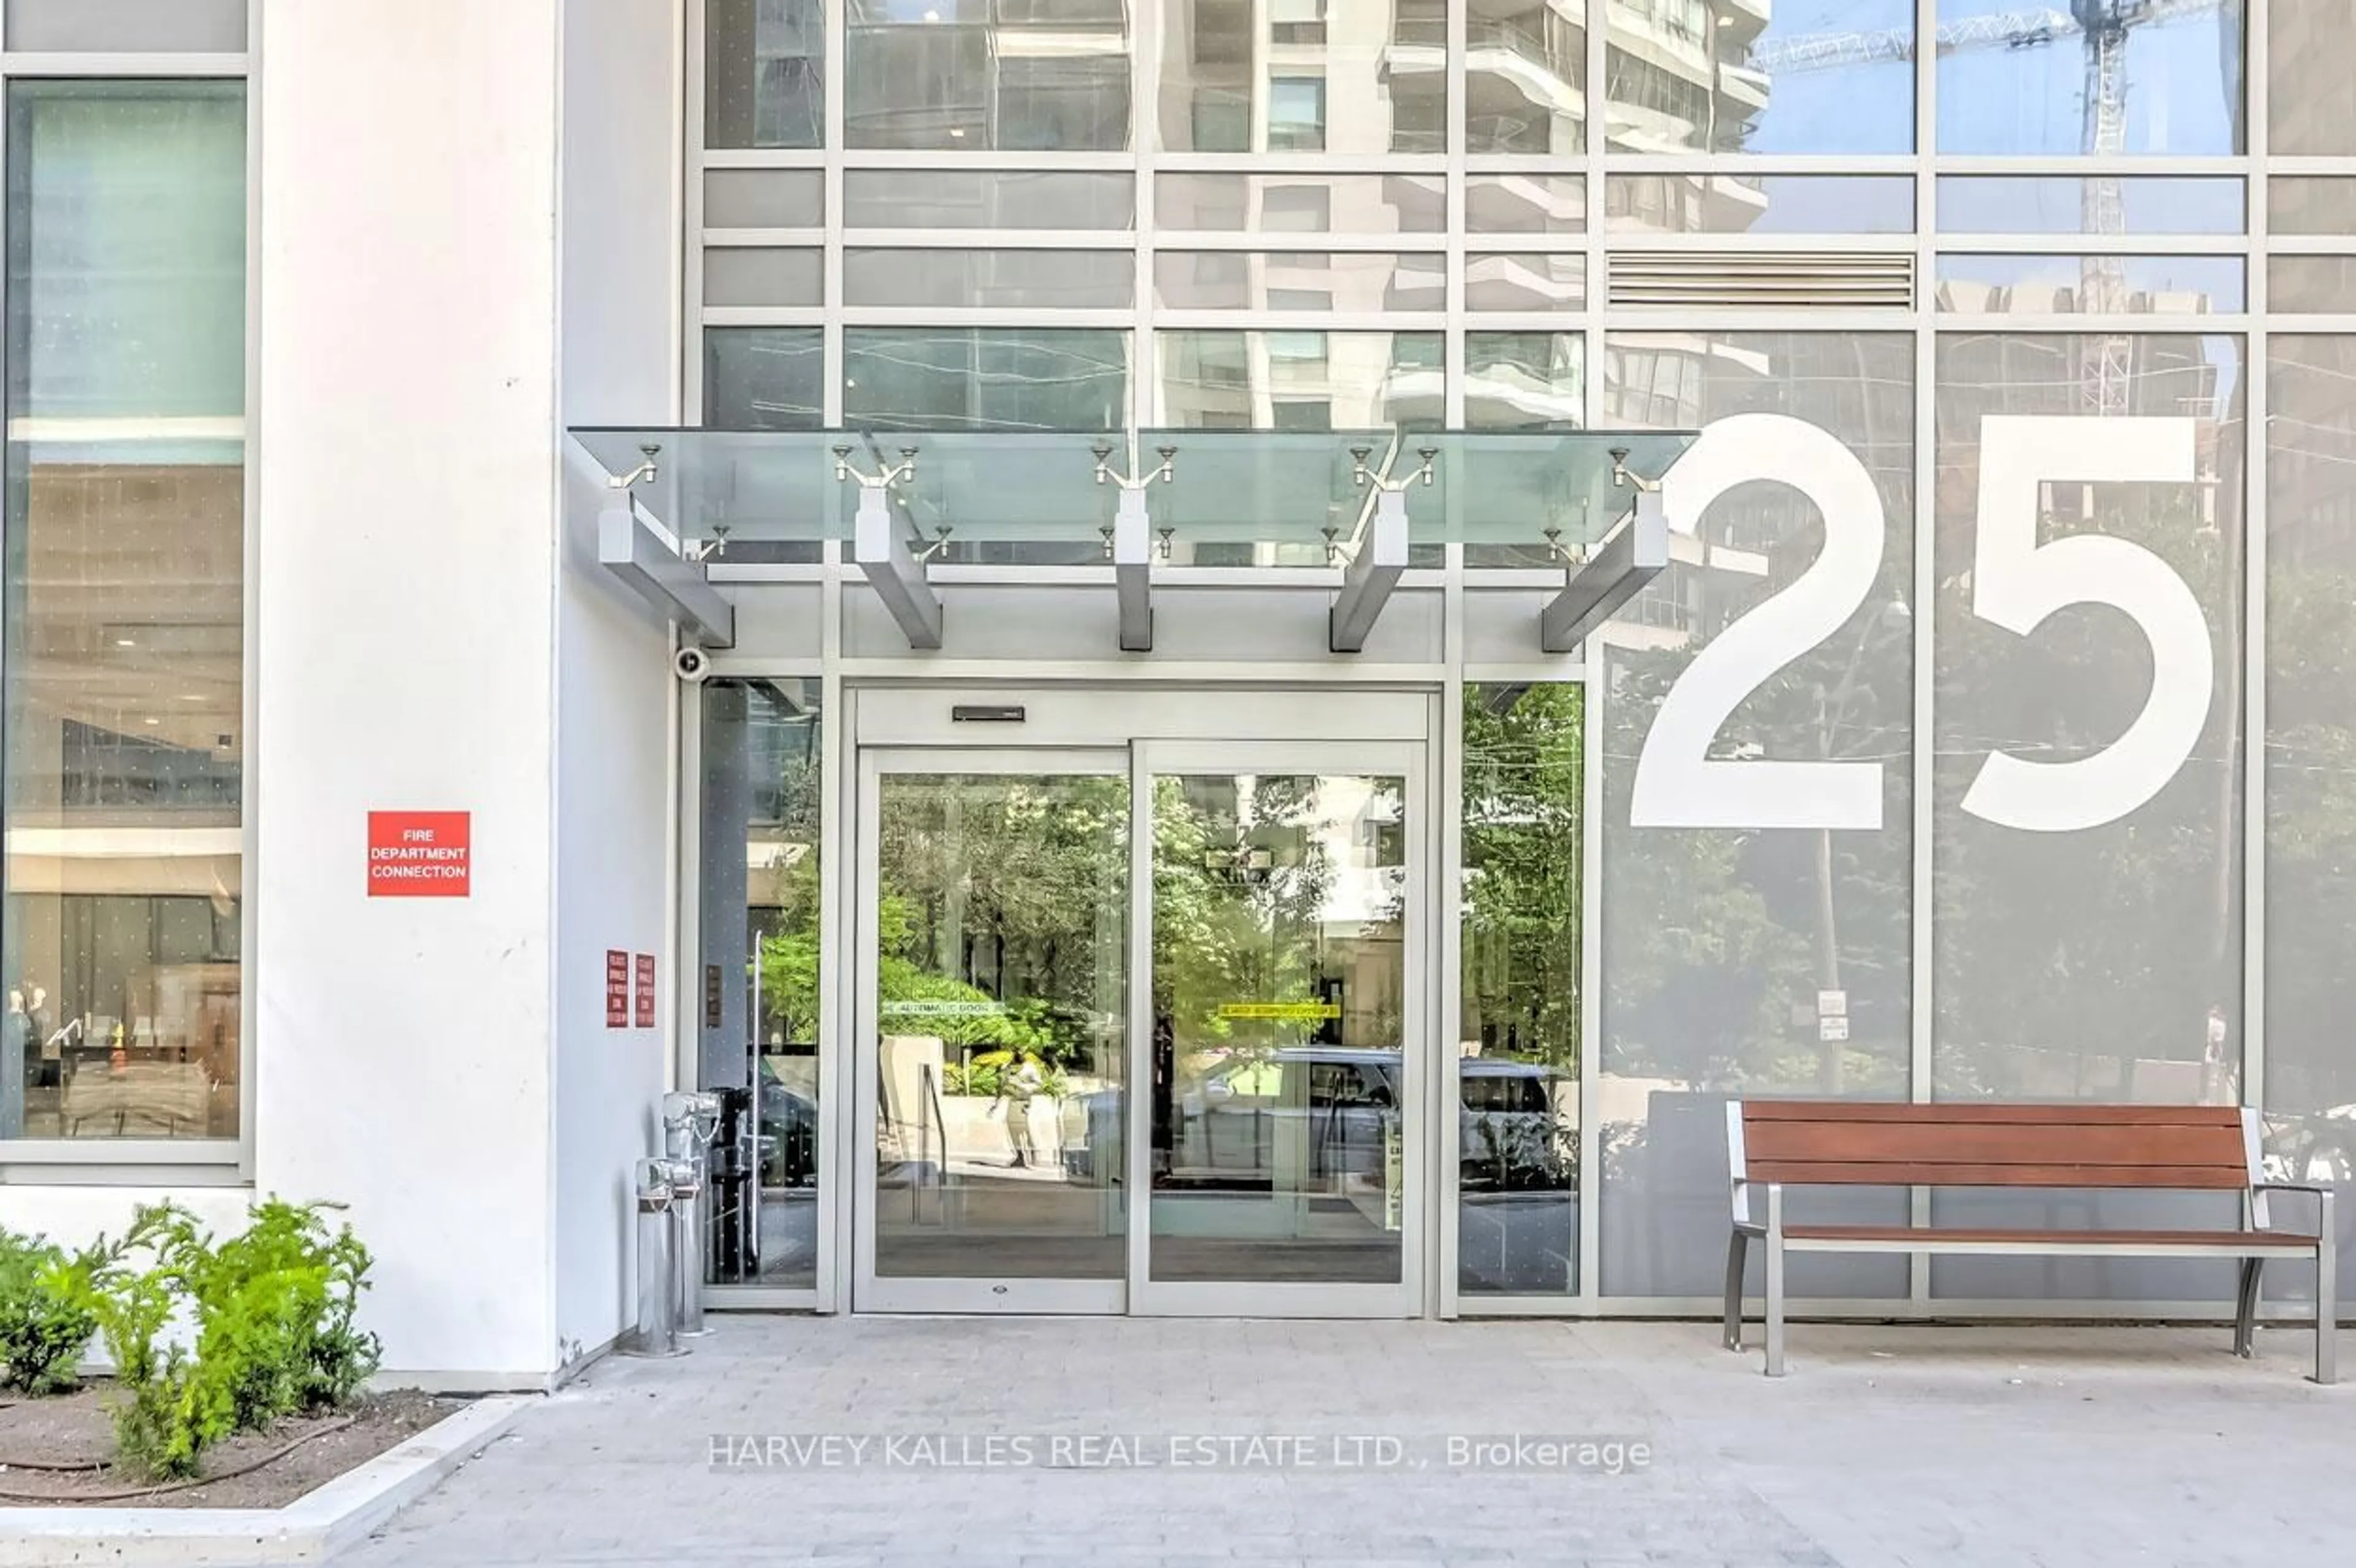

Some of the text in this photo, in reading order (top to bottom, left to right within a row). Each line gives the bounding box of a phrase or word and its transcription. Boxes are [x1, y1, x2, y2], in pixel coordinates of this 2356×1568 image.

[1630, 413, 2212, 831] 25
[403, 829, 434, 842] FIRE
[371, 847, 466, 859] DEPARTMENT
[371, 866, 466, 878] CONNECTION
